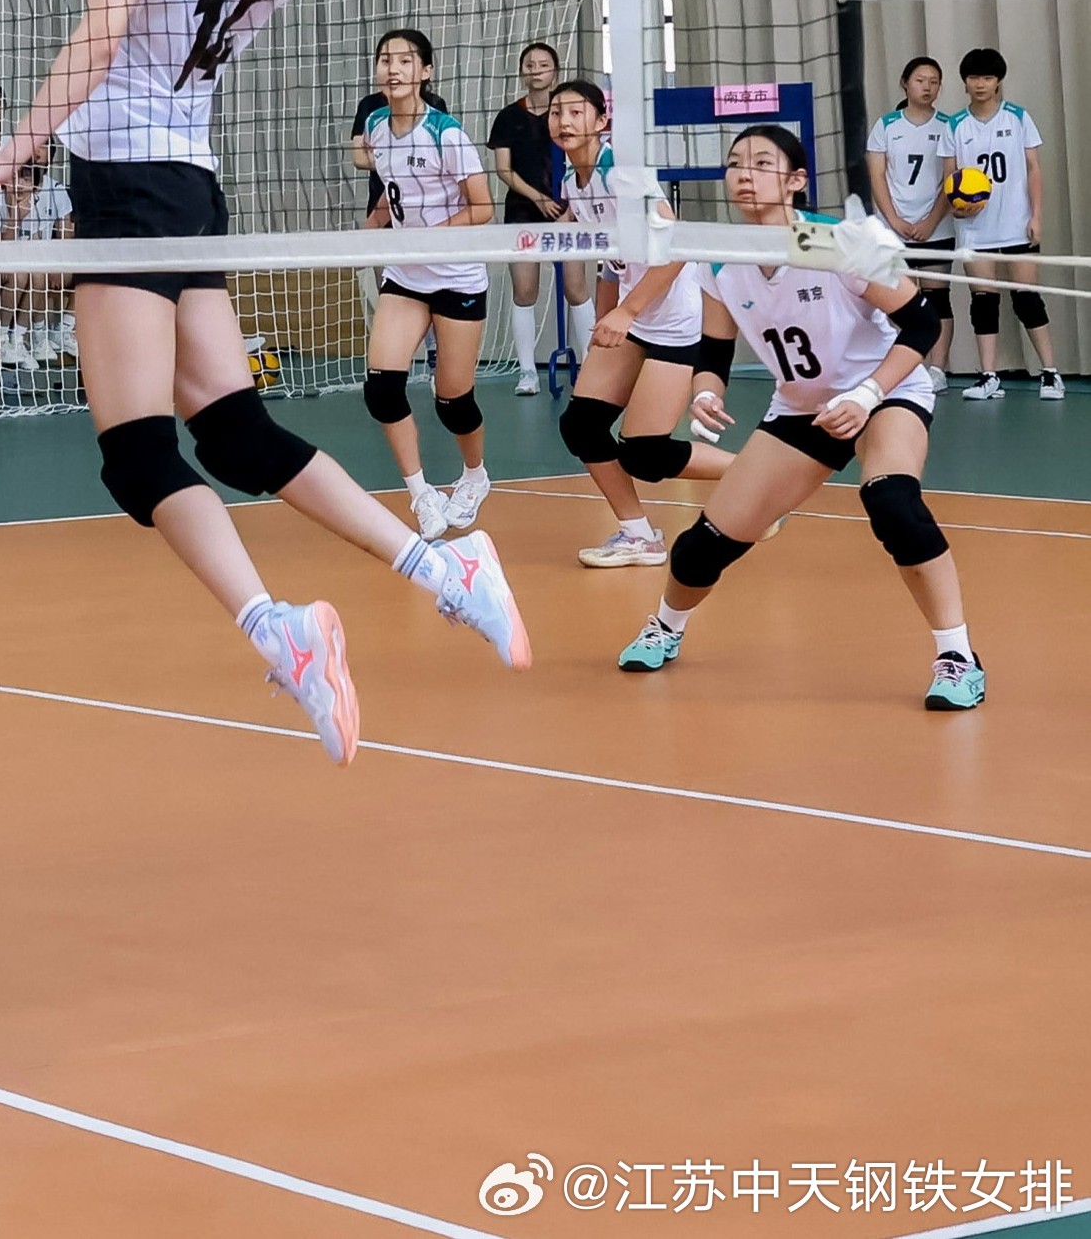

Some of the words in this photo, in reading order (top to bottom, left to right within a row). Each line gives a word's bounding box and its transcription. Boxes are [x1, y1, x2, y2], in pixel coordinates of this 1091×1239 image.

[723, 89, 769, 104] 南京市
[907, 154, 924, 186] 7
[388, 180, 405, 223] 8
[796, 285, 824, 303] 南京
[762, 326, 822, 382] 13
